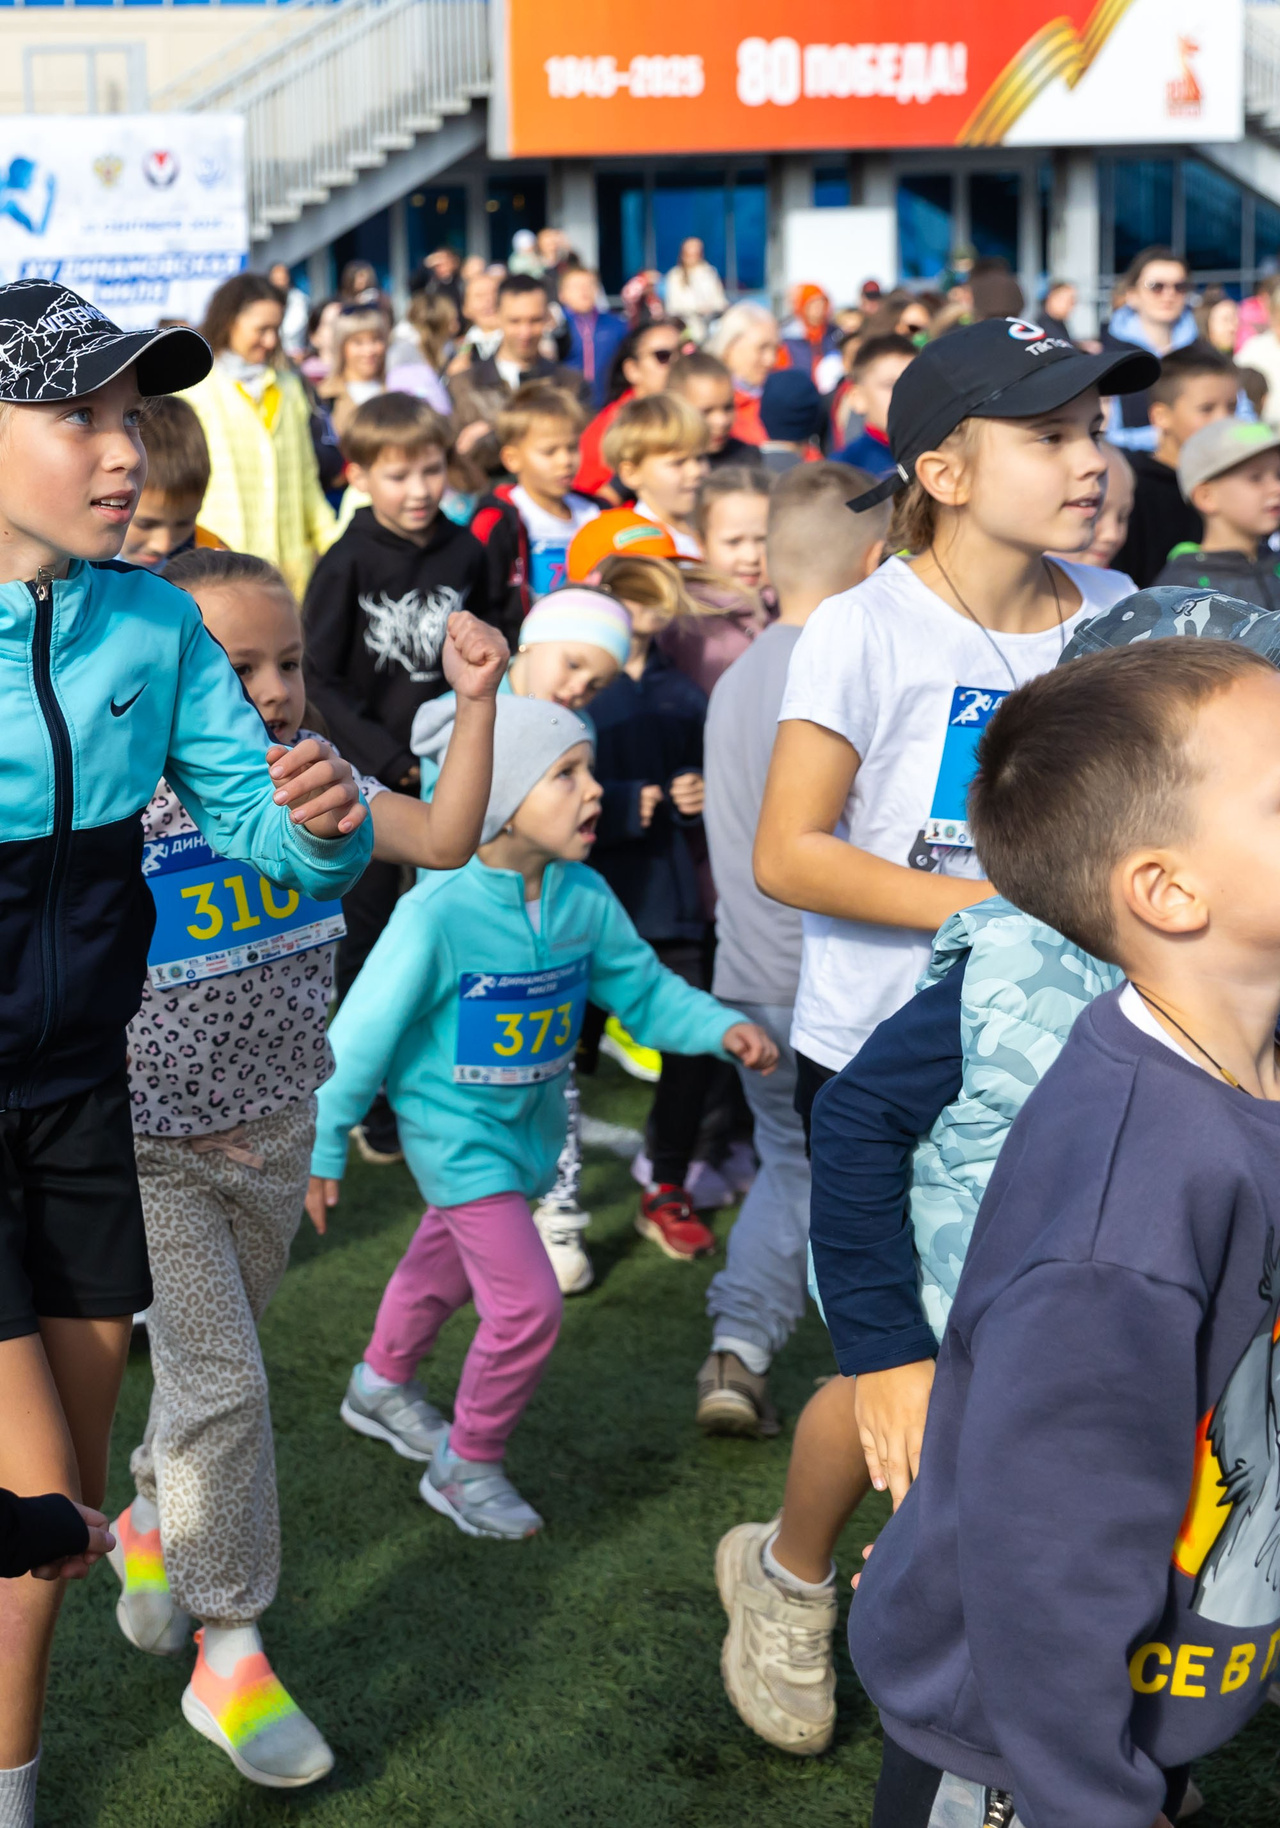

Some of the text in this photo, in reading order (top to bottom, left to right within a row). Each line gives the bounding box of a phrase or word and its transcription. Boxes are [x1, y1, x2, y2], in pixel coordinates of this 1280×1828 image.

[737, 36, 967, 107] 80 ПОБЕДА!
[493, 1002, 572, 1057] 373
[1221, 1642, 1257, 1695] В
